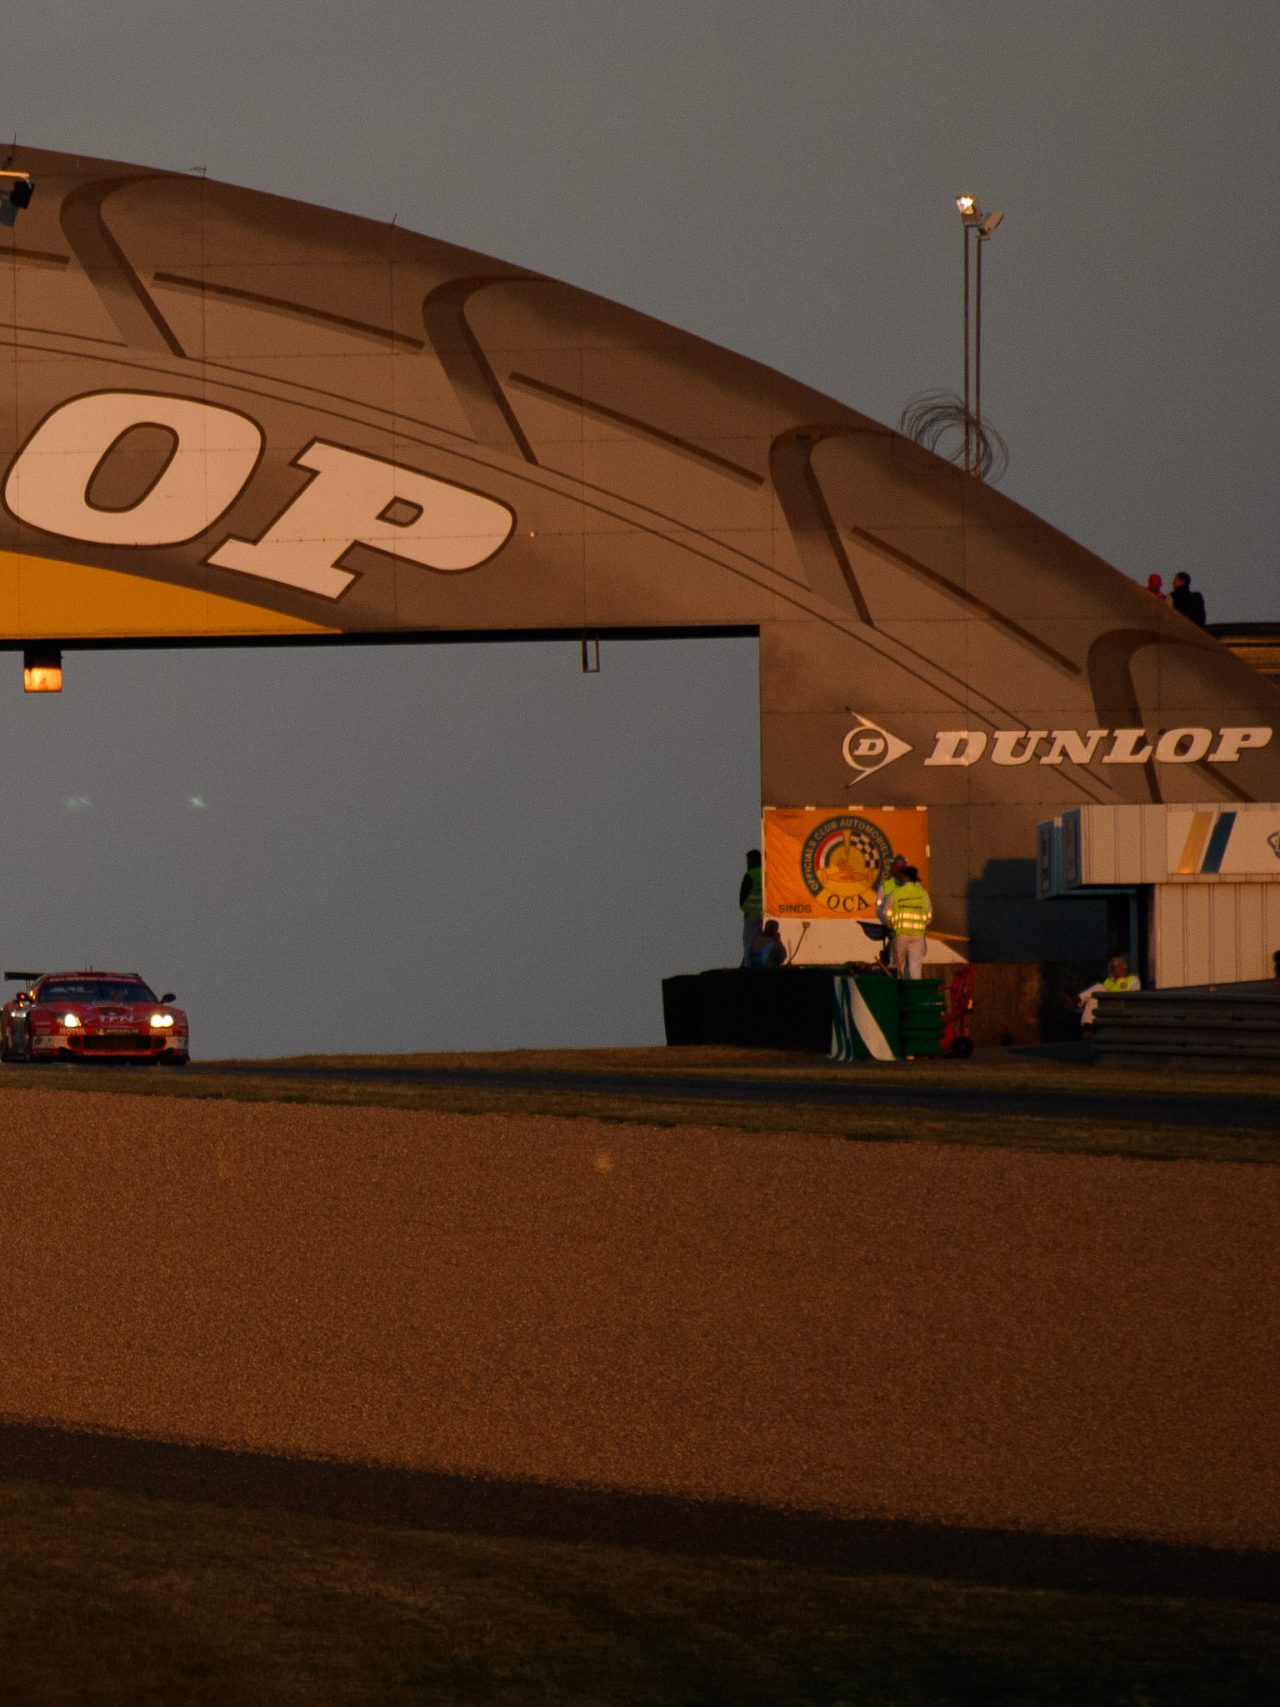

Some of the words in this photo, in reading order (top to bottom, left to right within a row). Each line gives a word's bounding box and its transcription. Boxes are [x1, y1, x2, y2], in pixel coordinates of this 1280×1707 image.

[852, 738, 886, 757] D
[924, 727, 1273, 767] DUNLOP
[778, 904, 812, 914] SINDS
[827, 894, 871, 913] OCA
